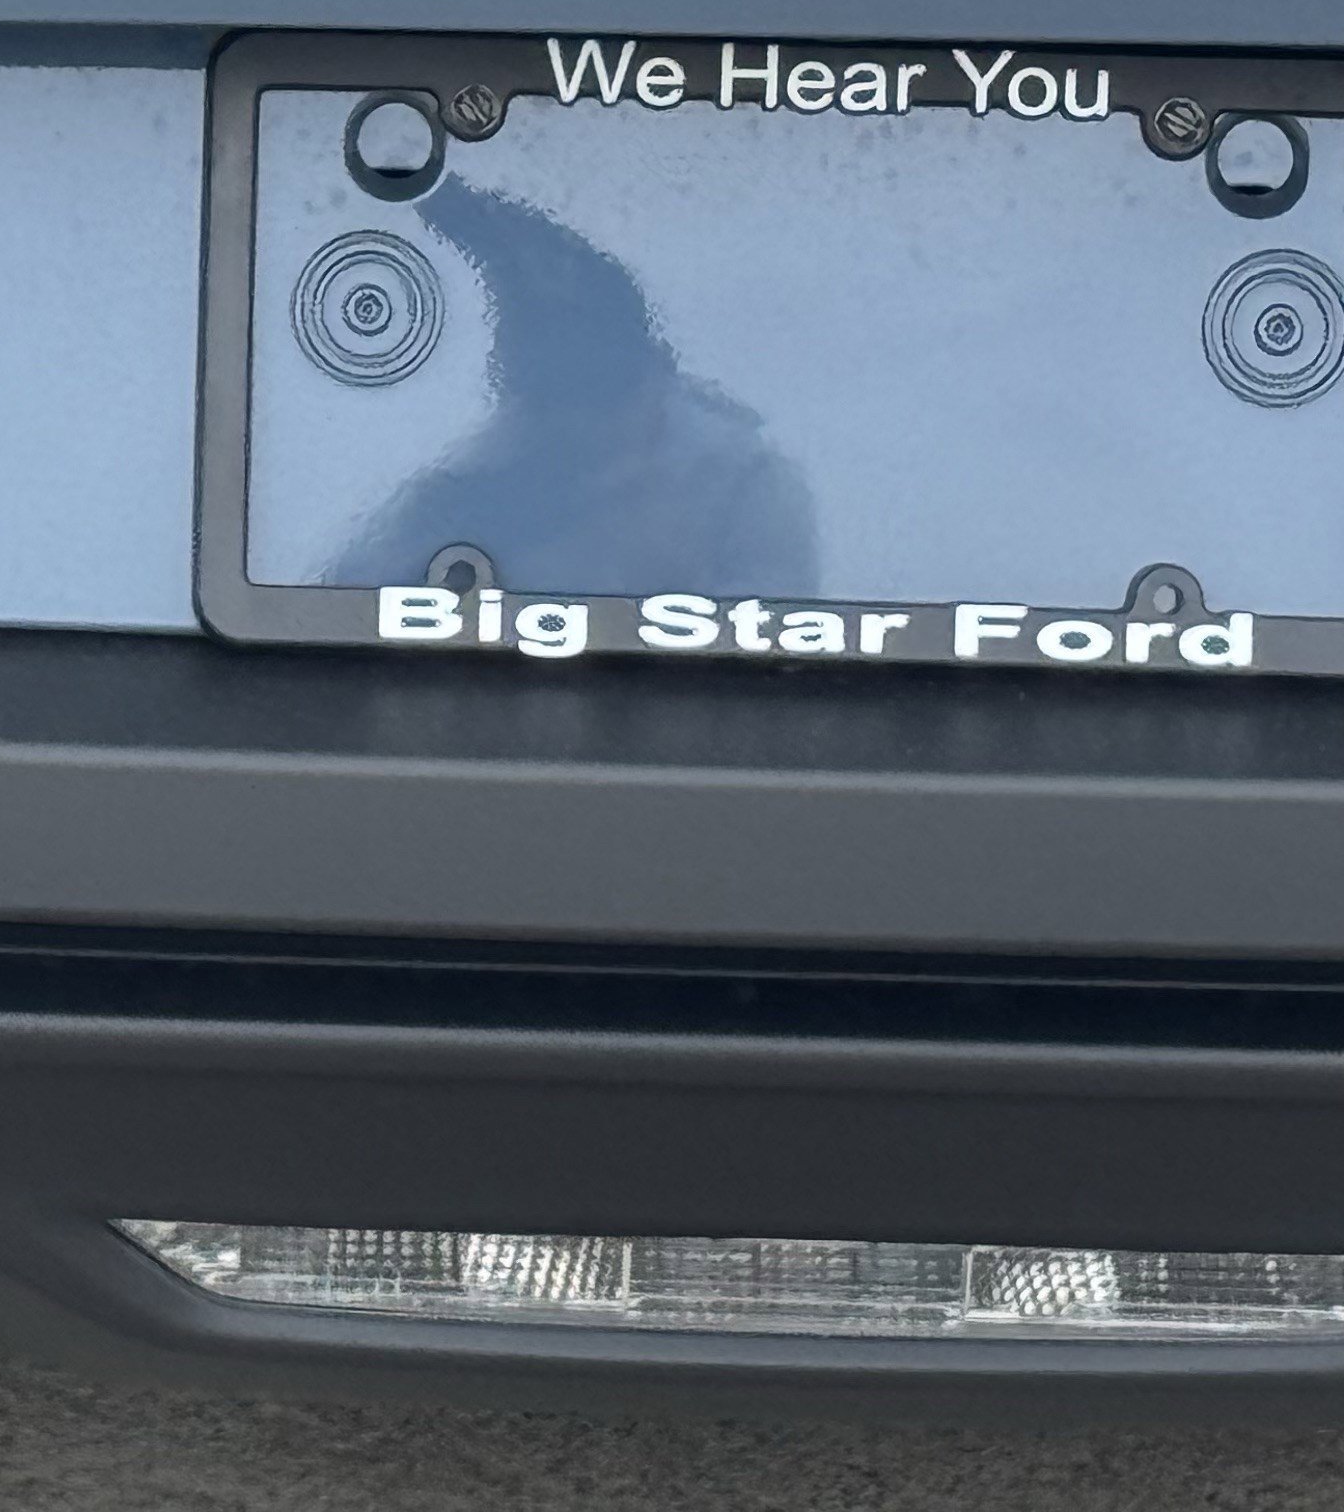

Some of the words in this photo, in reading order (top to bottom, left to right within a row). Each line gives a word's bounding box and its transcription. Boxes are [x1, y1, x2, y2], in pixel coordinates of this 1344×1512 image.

[546, 38, 686, 108] We
[721, 43, 926, 113] Hear
[953, 49, 1111, 119] You
[376, 584, 590, 658] Big
[639, 593, 910, 655] Star
[952, 603, 1256, 668] Ford
